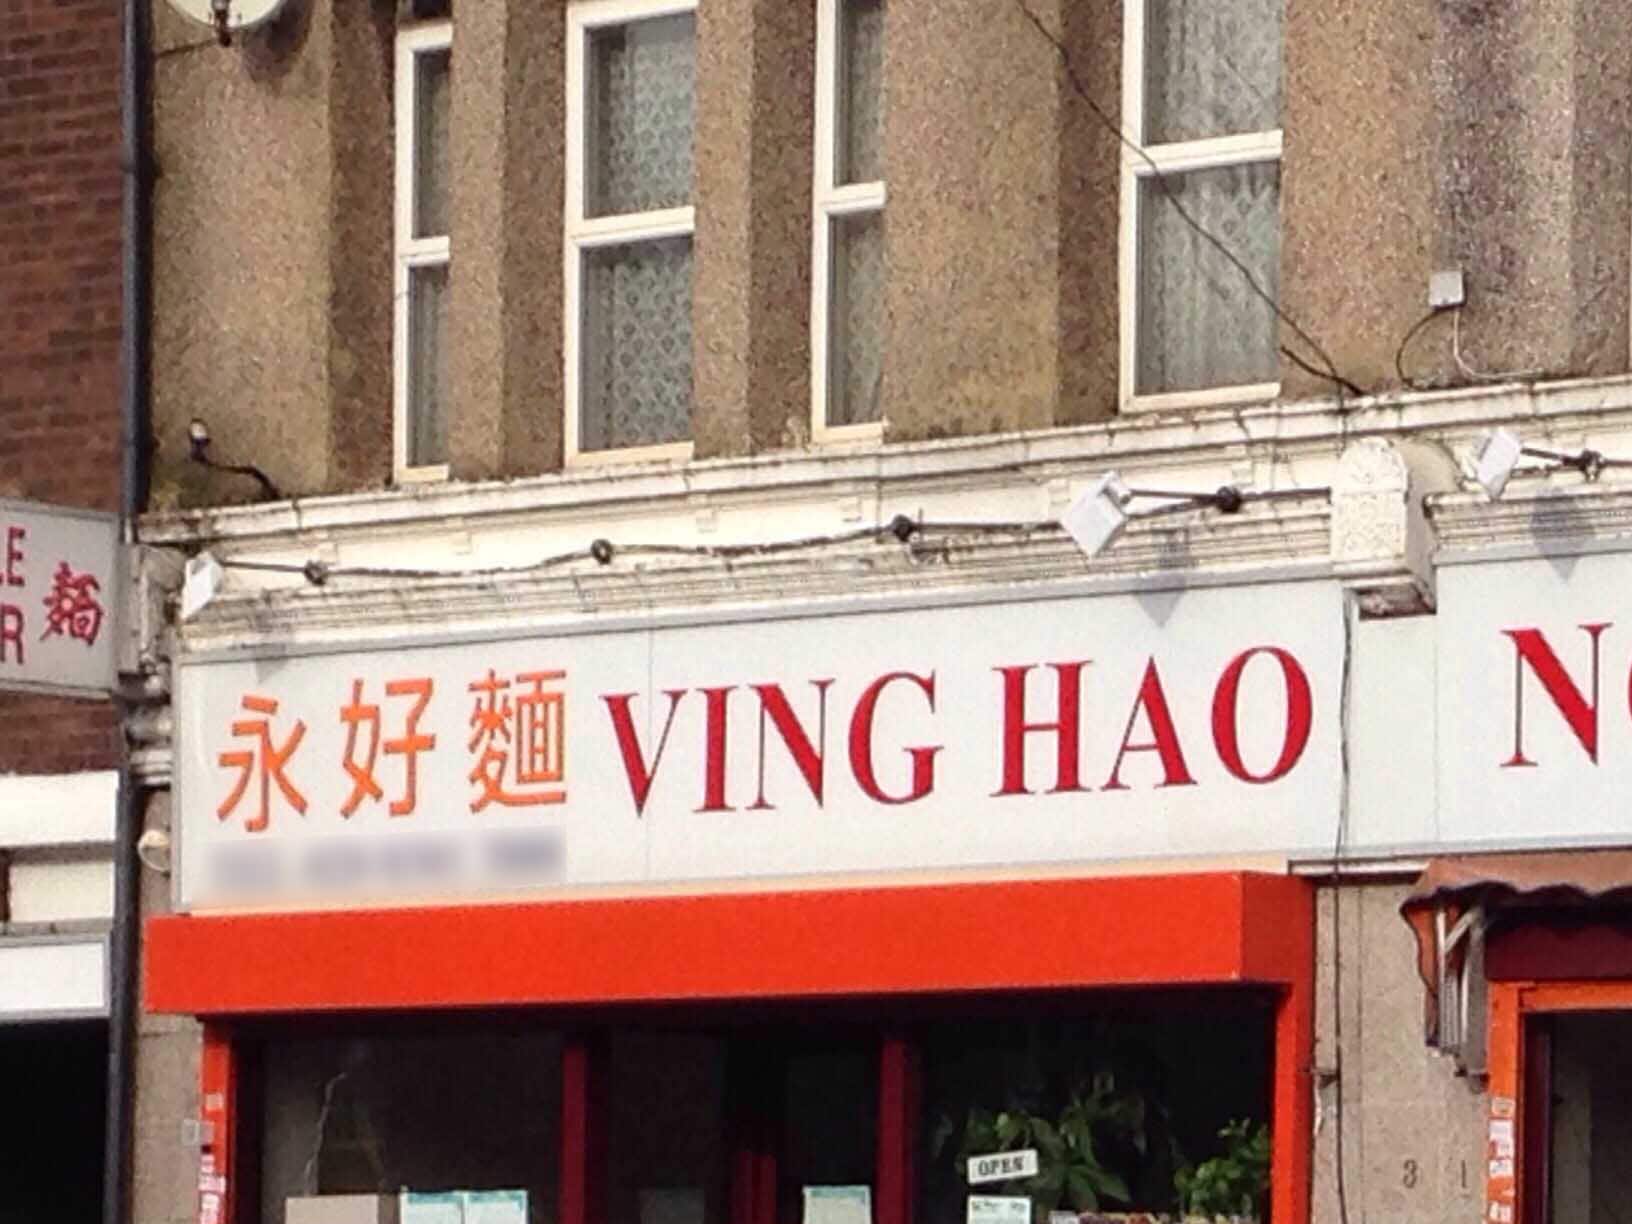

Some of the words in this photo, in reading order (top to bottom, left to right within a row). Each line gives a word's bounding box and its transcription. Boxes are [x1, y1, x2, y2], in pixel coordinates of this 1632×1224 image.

[0, 525, 26, 587] E
[216, 668, 568, 833] 永好麵
[600, 670, 943, 818] VING
[989, 645, 1313, 798] HAO
[978, 1155, 1026, 1176] OPEN
